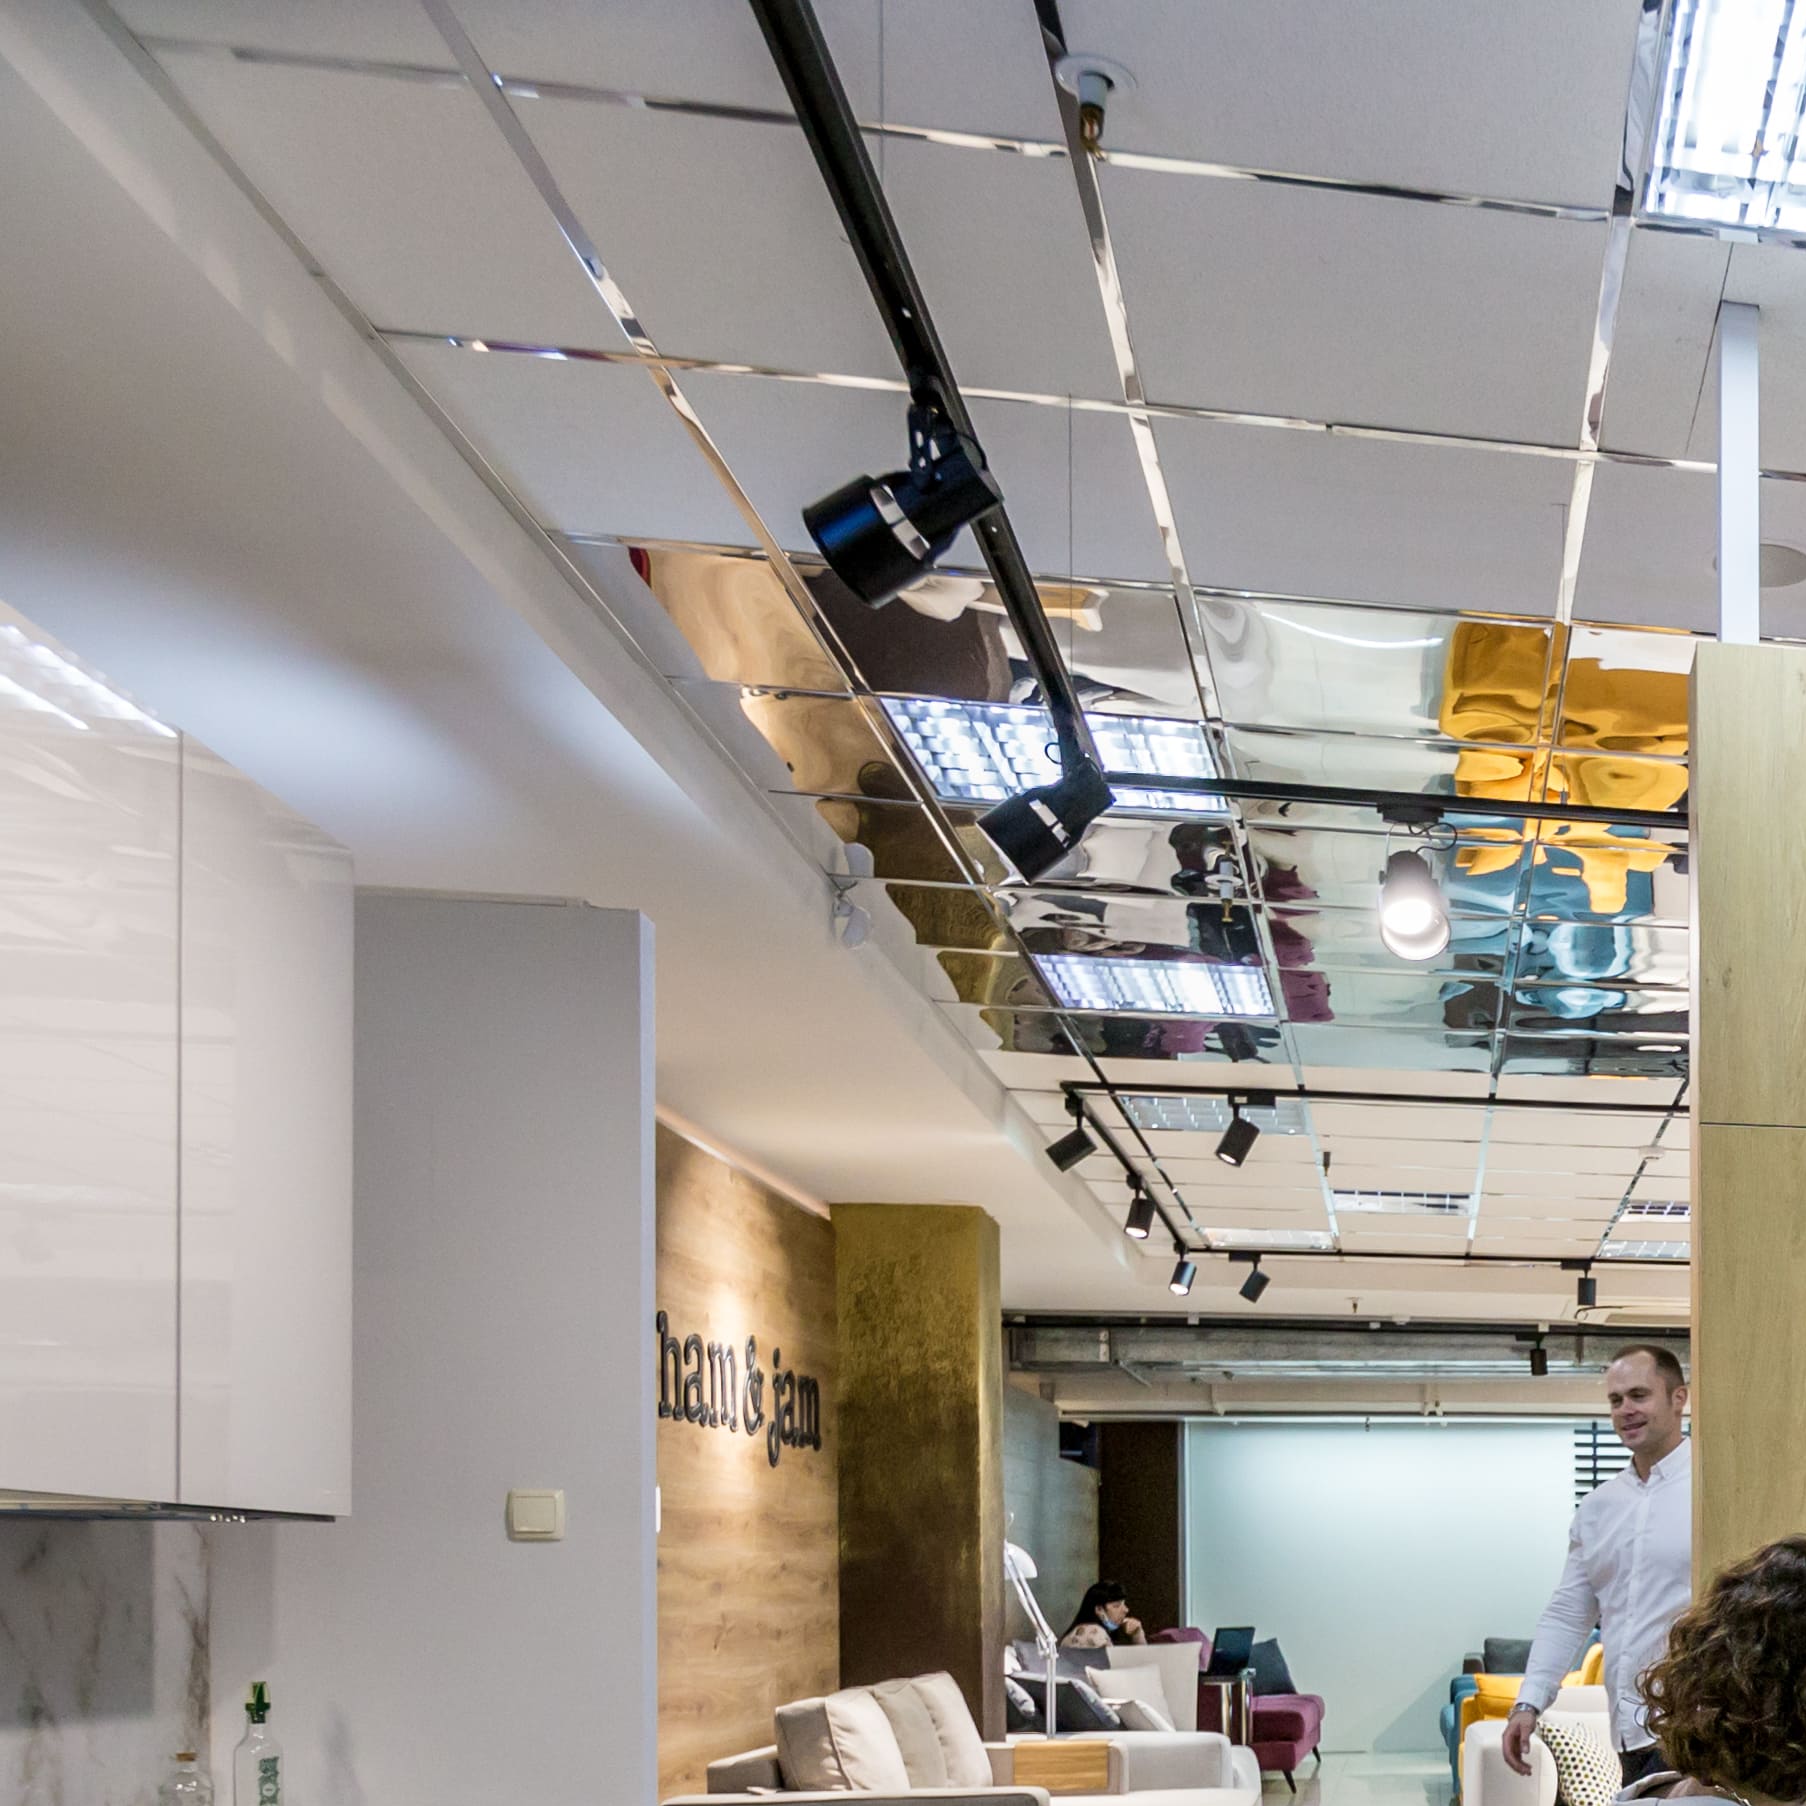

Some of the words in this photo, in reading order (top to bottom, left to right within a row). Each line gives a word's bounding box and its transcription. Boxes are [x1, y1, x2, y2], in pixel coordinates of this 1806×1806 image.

[656, 1310, 738, 1433] ham
[743, 1335, 764, 1436] &
[768, 1347, 821, 1468] jam
